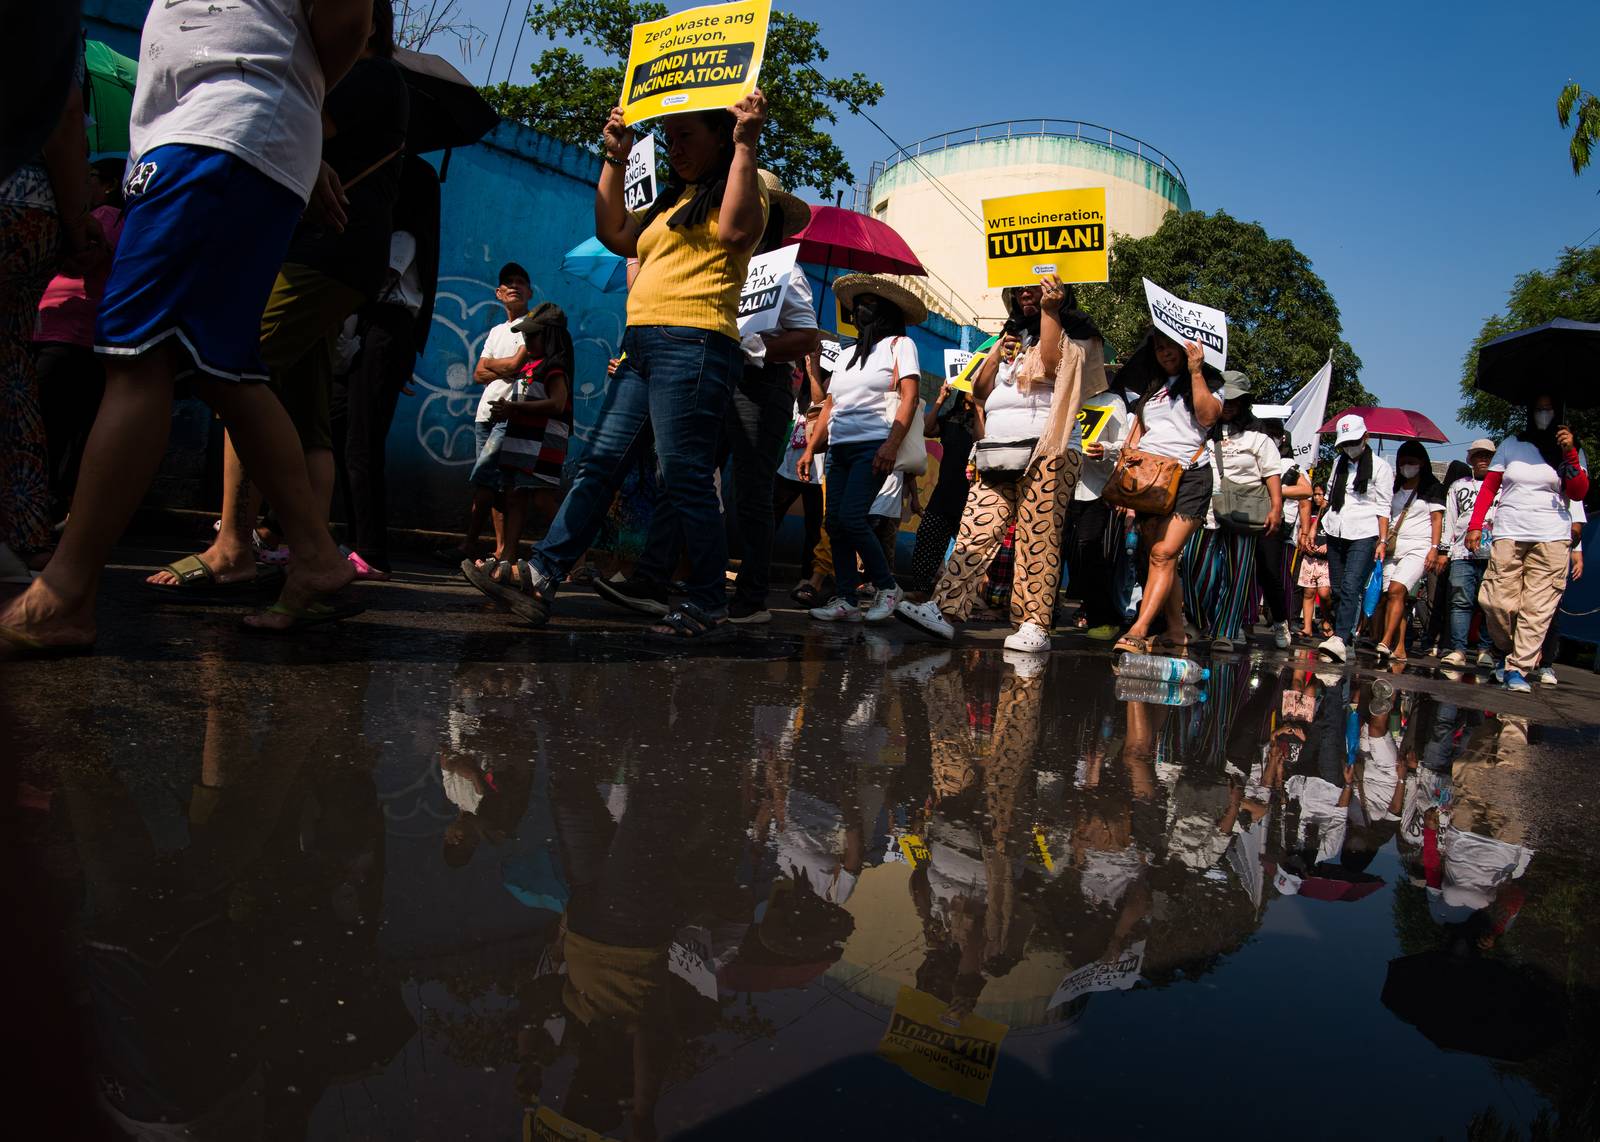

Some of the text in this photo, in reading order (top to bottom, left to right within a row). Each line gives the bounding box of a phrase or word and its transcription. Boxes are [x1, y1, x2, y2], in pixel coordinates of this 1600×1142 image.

[644, 12, 755, 44] Zero waste ang
[658, 30, 727, 51] solusyon,
[649, 50, 728, 77] HINDI WTE
[632, 64, 743, 99] INCINERATION!
[625, 163, 647, 184] ANGIS
[988, 209, 1104, 229] WTE Incineration,
[990, 226, 1100, 255] TUTULAN!
[752, 273, 777, 290] TAX
[1156, 299, 1217, 332] EXCISE TAX
[1164, 297, 1203, 318] VAT AT
[1155, 309, 1221, 349] TANGGALIN
